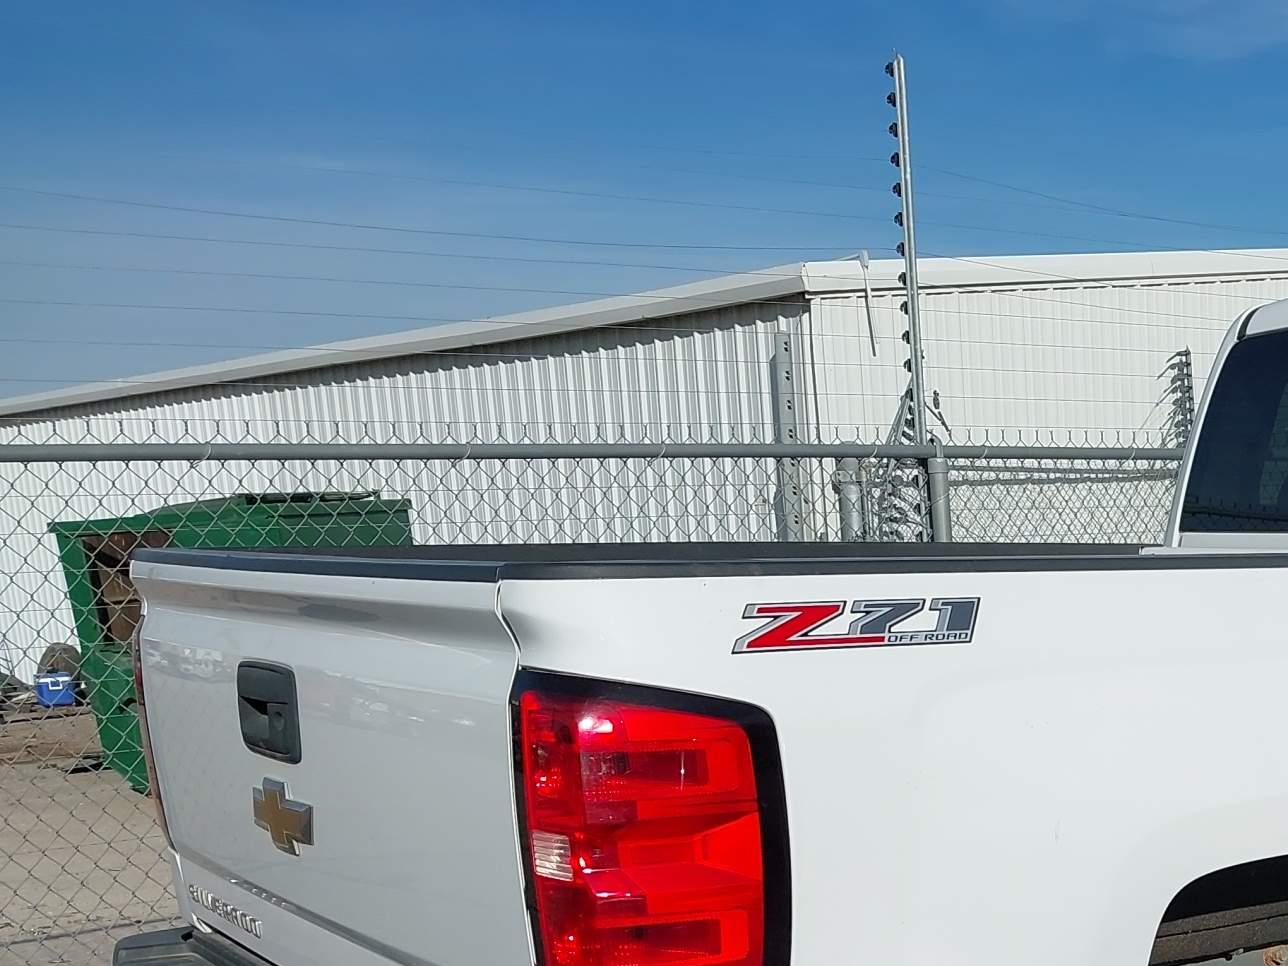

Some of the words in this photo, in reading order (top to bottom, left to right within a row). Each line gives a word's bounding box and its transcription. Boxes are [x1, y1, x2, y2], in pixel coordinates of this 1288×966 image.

[731, 597, 981, 655] Z71
[887, 633, 921, 644] OFF
[923, 631, 969, 643] ROAD
